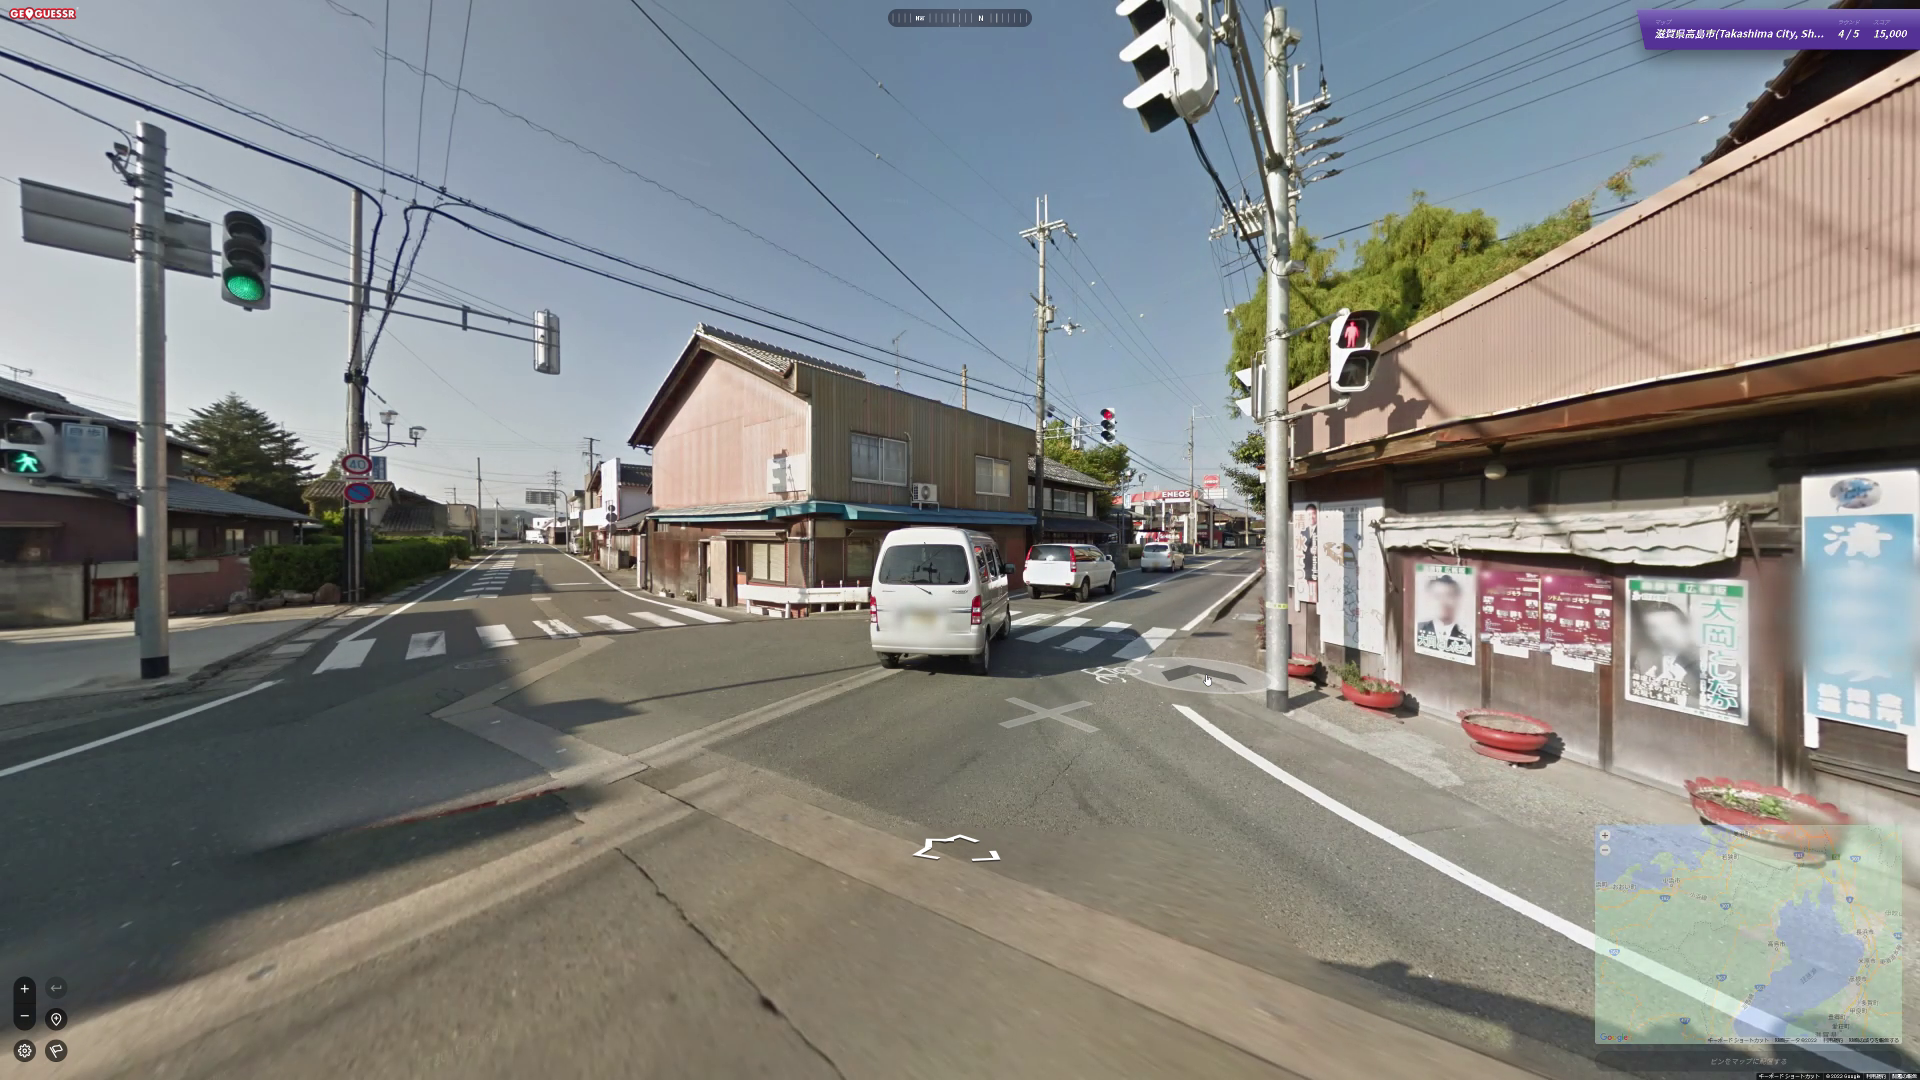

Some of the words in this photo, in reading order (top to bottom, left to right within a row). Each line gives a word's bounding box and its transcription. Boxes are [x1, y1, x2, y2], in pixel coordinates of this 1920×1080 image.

[349, 459, 366, 470] 40
[1162, 490, 1191, 498] ENEOS
[1700, 599, 1739, 711] 大岡としたか
